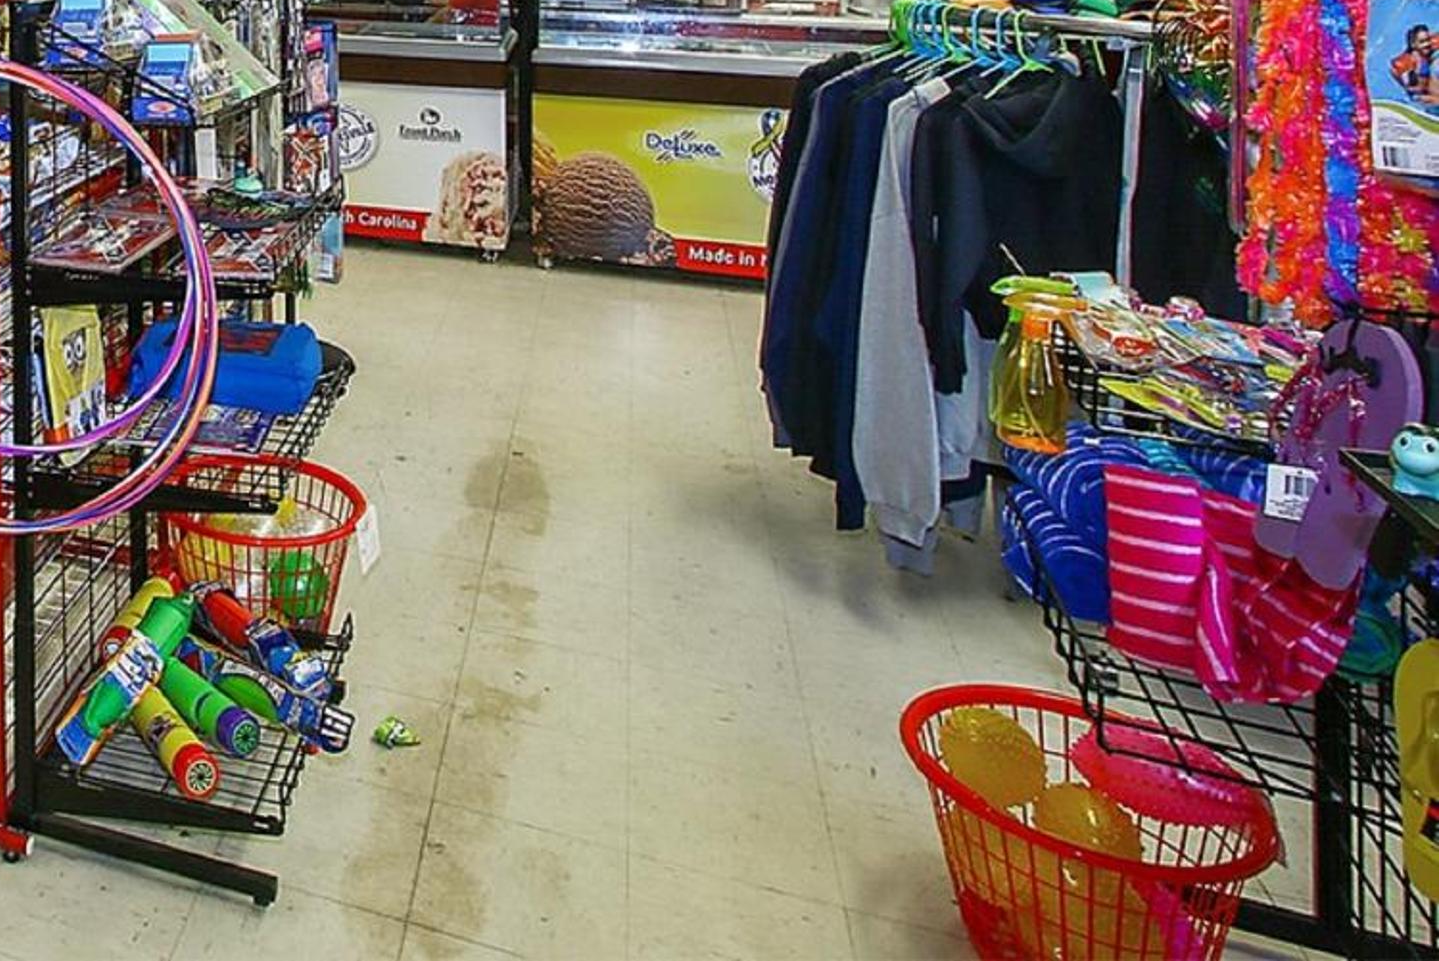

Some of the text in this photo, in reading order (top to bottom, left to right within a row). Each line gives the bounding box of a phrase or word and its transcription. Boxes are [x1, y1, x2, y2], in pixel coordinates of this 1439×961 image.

[646, 133, 720, 157] Deluxe
[358, 211, 417, 231] Carolina
[688, 246, 734, 264] Made
[739, 251, 755, 266] in
